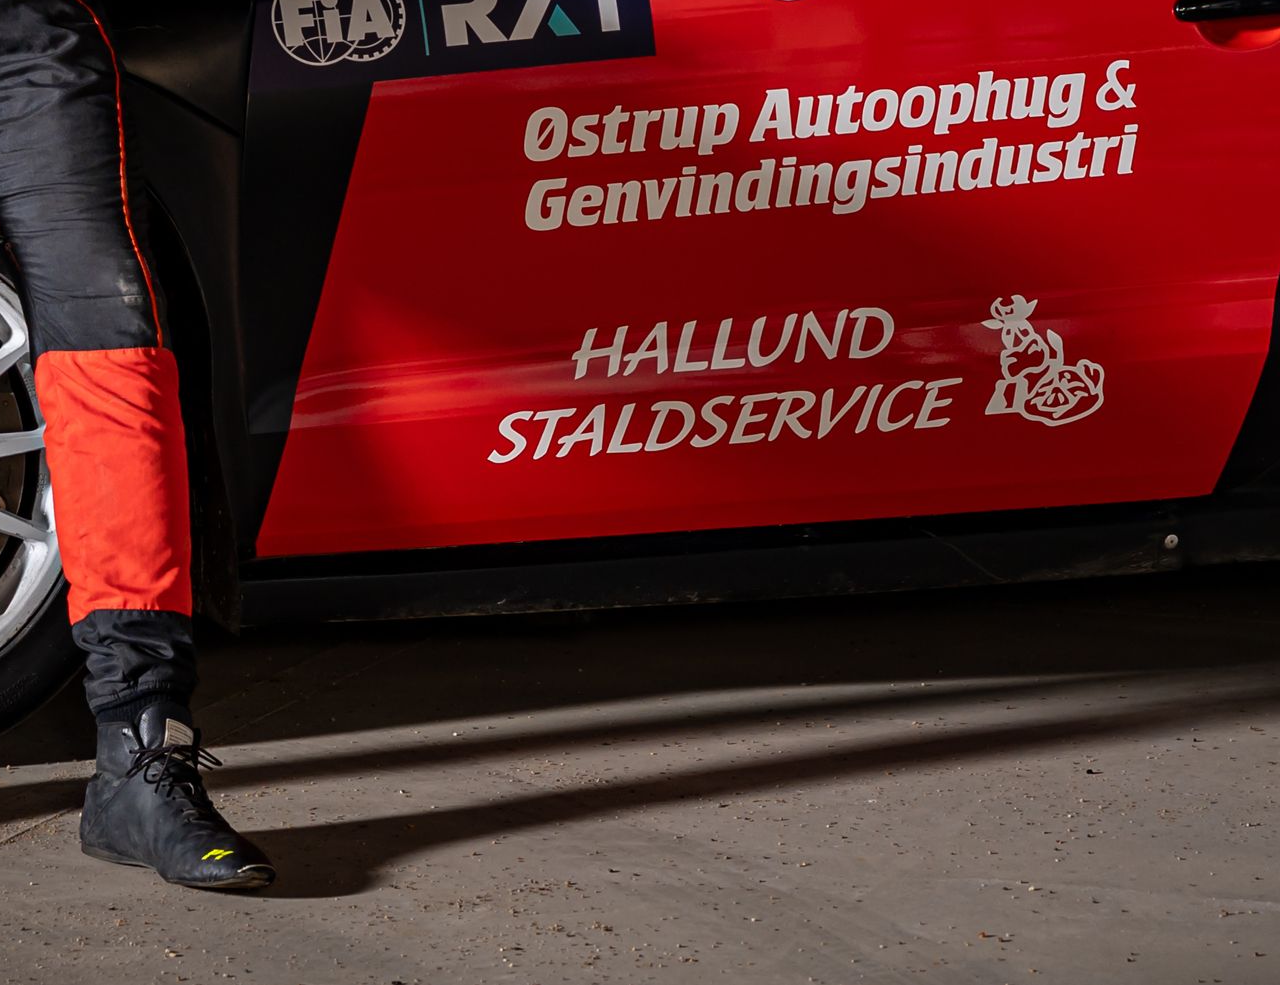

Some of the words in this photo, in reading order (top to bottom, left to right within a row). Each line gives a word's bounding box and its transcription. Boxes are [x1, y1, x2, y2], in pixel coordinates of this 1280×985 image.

[523, 102, 741, 162] Østrup
[748, 68, 1077, 144] Autoophug
[1082, 59, 1137, 112] &
[523, 123, 1137, 233] Genvindingsindustri
[572, 306, 895, 380] HALLUND
[486, 377, 963, 464] STALDSERVICE
